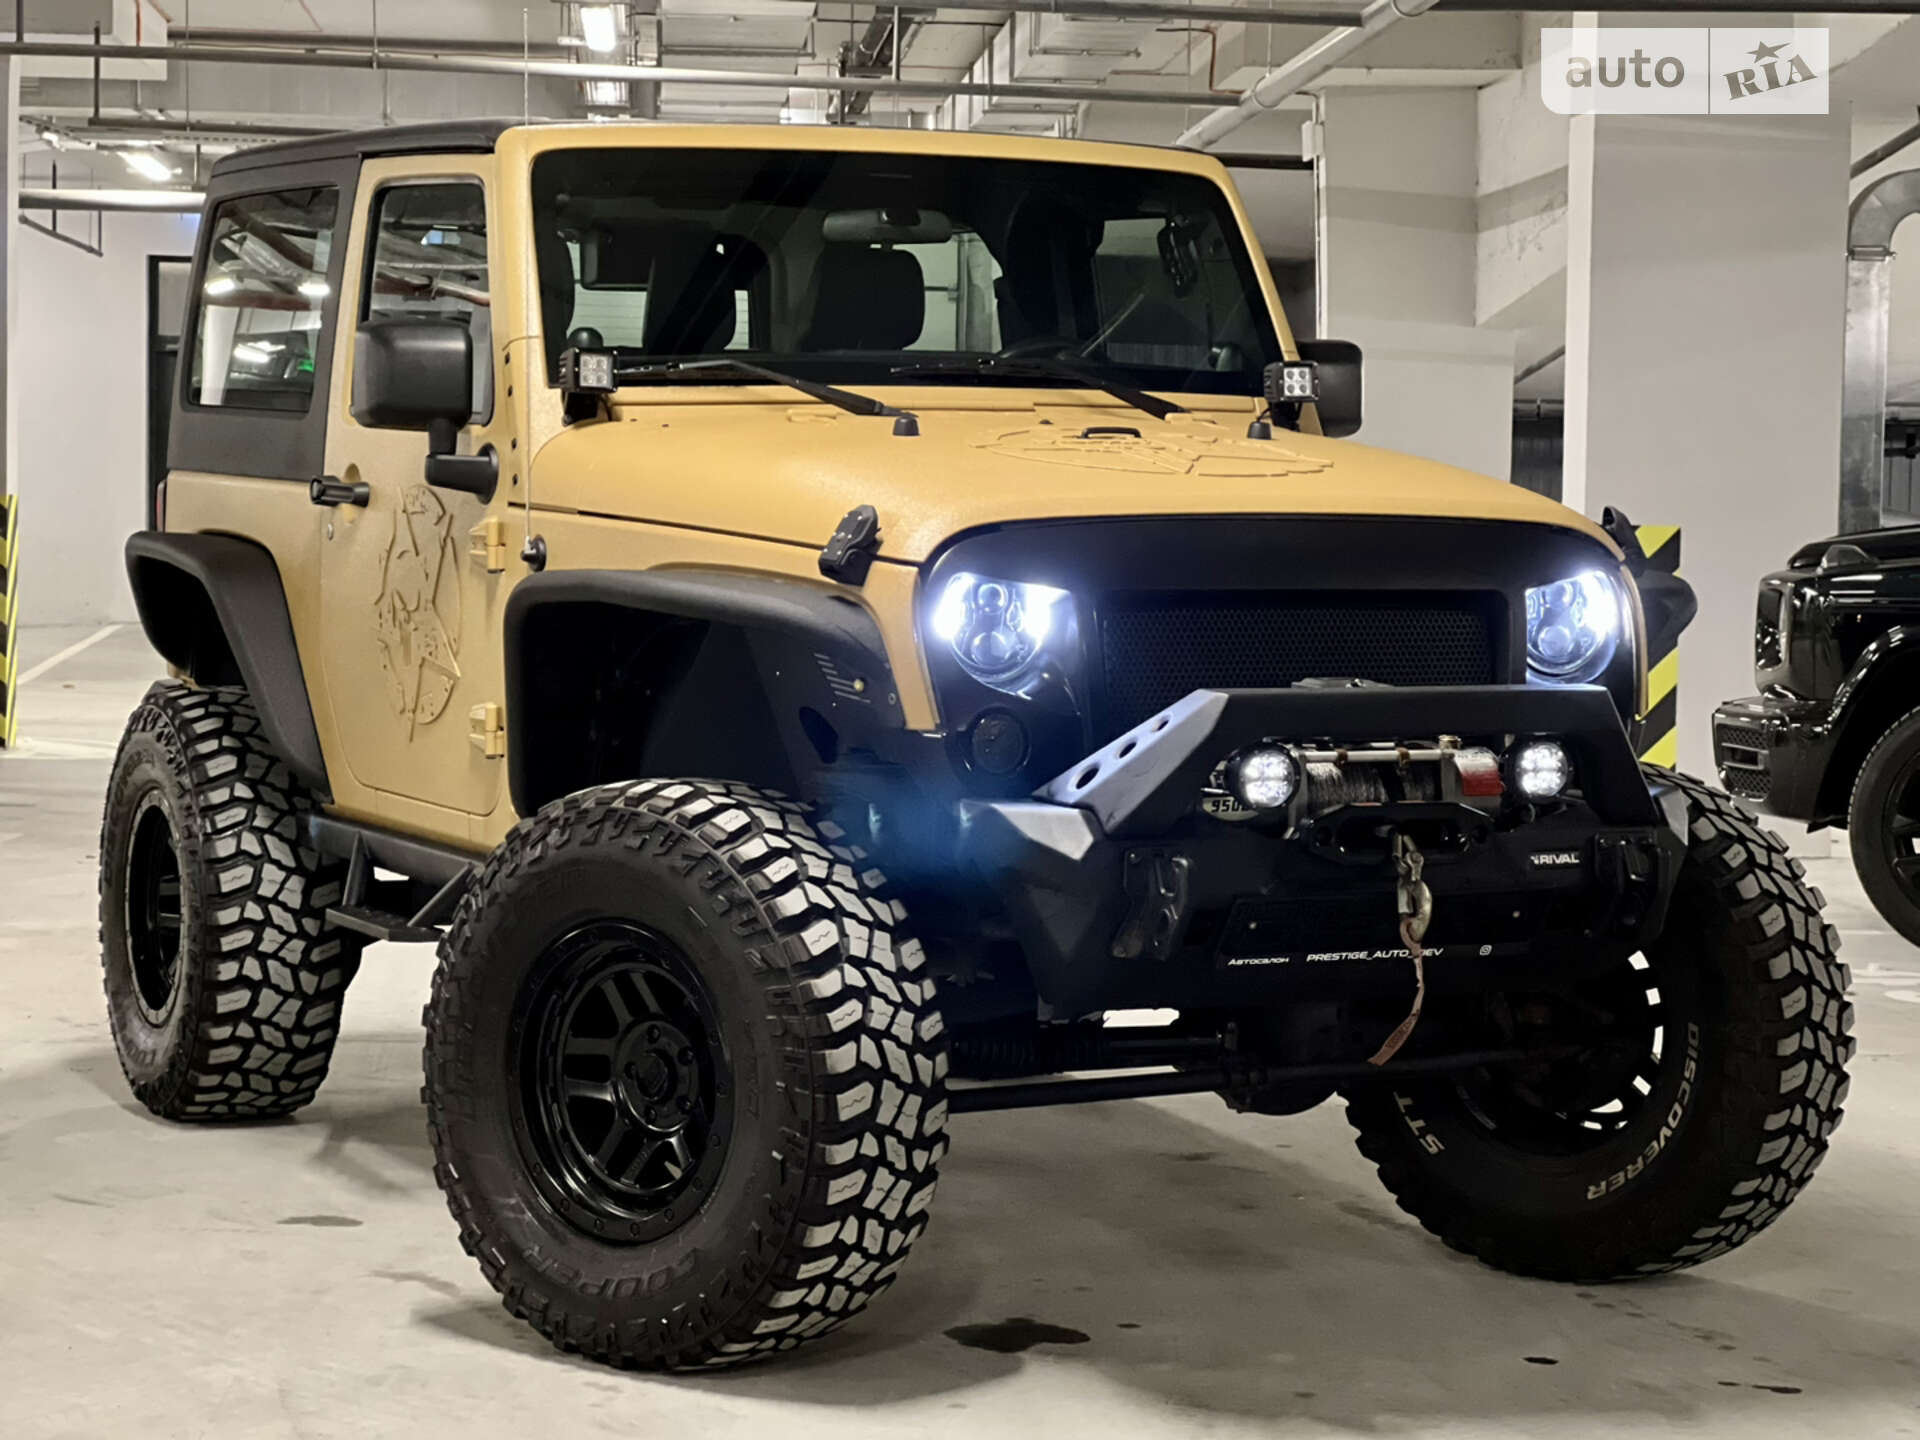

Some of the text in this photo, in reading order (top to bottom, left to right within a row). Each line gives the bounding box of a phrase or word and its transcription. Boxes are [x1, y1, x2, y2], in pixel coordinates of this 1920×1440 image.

[1539, 853, 1580, 865] RIVAL
[1392, 1091, 1446, 1155] STT
[1586, 1021, 1700, 1200] DISCOVERER
